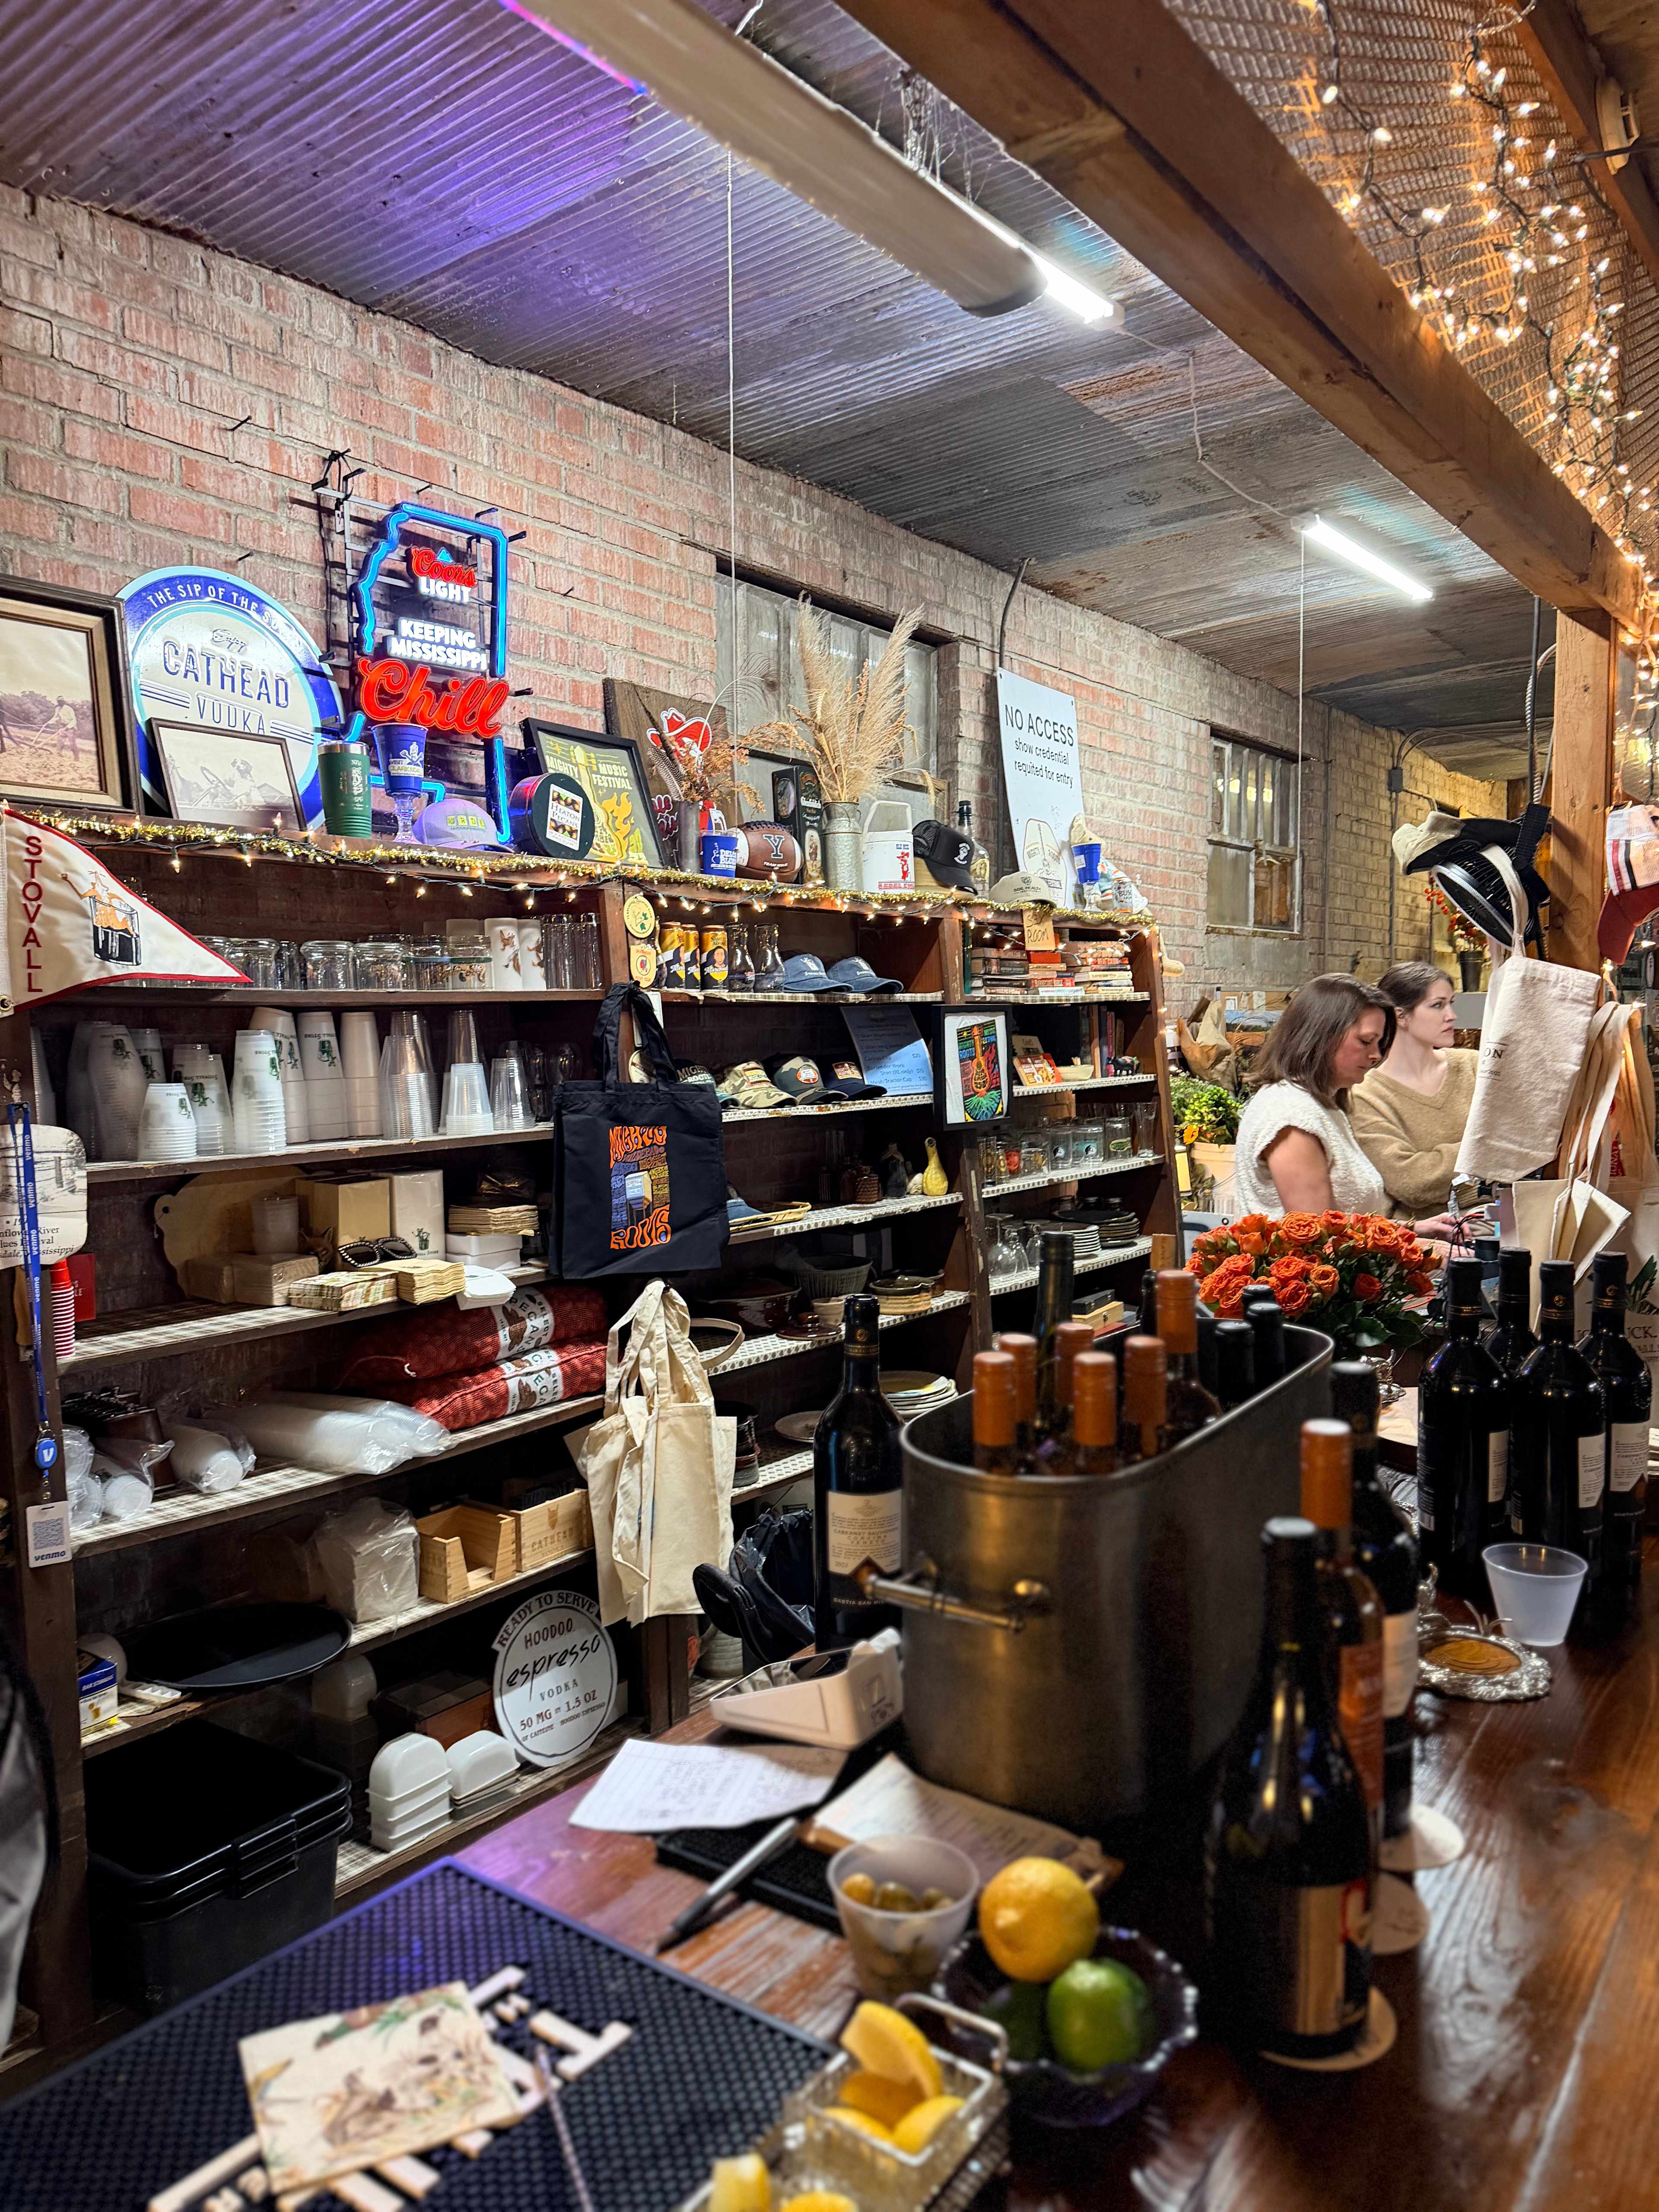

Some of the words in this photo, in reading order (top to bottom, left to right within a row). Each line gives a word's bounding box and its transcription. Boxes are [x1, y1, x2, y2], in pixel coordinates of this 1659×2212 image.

[412, 546, 477, 587] Coors
[147, 587, 175, 608] THE
[177, 584, 201, 597] SIP
[207, 585, 225, 599] OF
[231, 592, 258, 614] THE
[420, 576, 471, 602] LIGHT
[400, 619, 476, 649] KEEPING
[391, 638, 488, 671] MISSISSIPPI
[163, 640, 289, 709] CATHEAD
[359, 658, 509, 738] Chill
[197, 695, 265, 734] VODKA
[1005, 705, 1023, 730] NO
[1028, 713, 1074, 747] ACCESS
[1015, 738, 1033, 754] show
[1035, 747, 1069, 765] credential
[545, 755, 578, 779] MIGHTY
[591, 774, 632, 790] FESTIVAL
[598, 763, 628, 777] MUSIC
[1045, 766, 1054, 781] for
[1056, 772, 1073, 788] entry
[551, 803, 580, 821] HEATON
[552, 811, 578, 828] PECANS
[763, 834, 785, 859] Y
[22, 836, 42, 993] STOVALL
[1027, 928, 1049, 943] ROOM
[610, 1125, 667, 1169] MIGHTY
[610, 1204, 671, 1250] ROOTS
[536, 1300, 550, 1338] SELECT
[531, 1527, 574, 1552] CATHEAD
[868, 1527, 898, 1536] SAUVIGNON
[35, 1551, 66, 1562] venmo
[497, 1602, 536, 1647] READY
[534, 1594, 553, 1607] TO
[557, 1592, 596, 1614] SERVE
[524, 1618, 573, 1649] HOODOO
[506, 1634, 600, 1701] espresso
[540, 1679, 579, 1701] VODKA
[520, 1717, 533, 1731] 50
[536, 1709, 553, 1724] MG
[565, 1697, 581, 1712] 1.5
[584, 1689, 597, 1703] OZ
[530, 1724, 554, 1738] CAFFEINE
[560, 1712, 581, 1726] HOODOO
[582, 1702, 606, 1716] ESPRESSO
